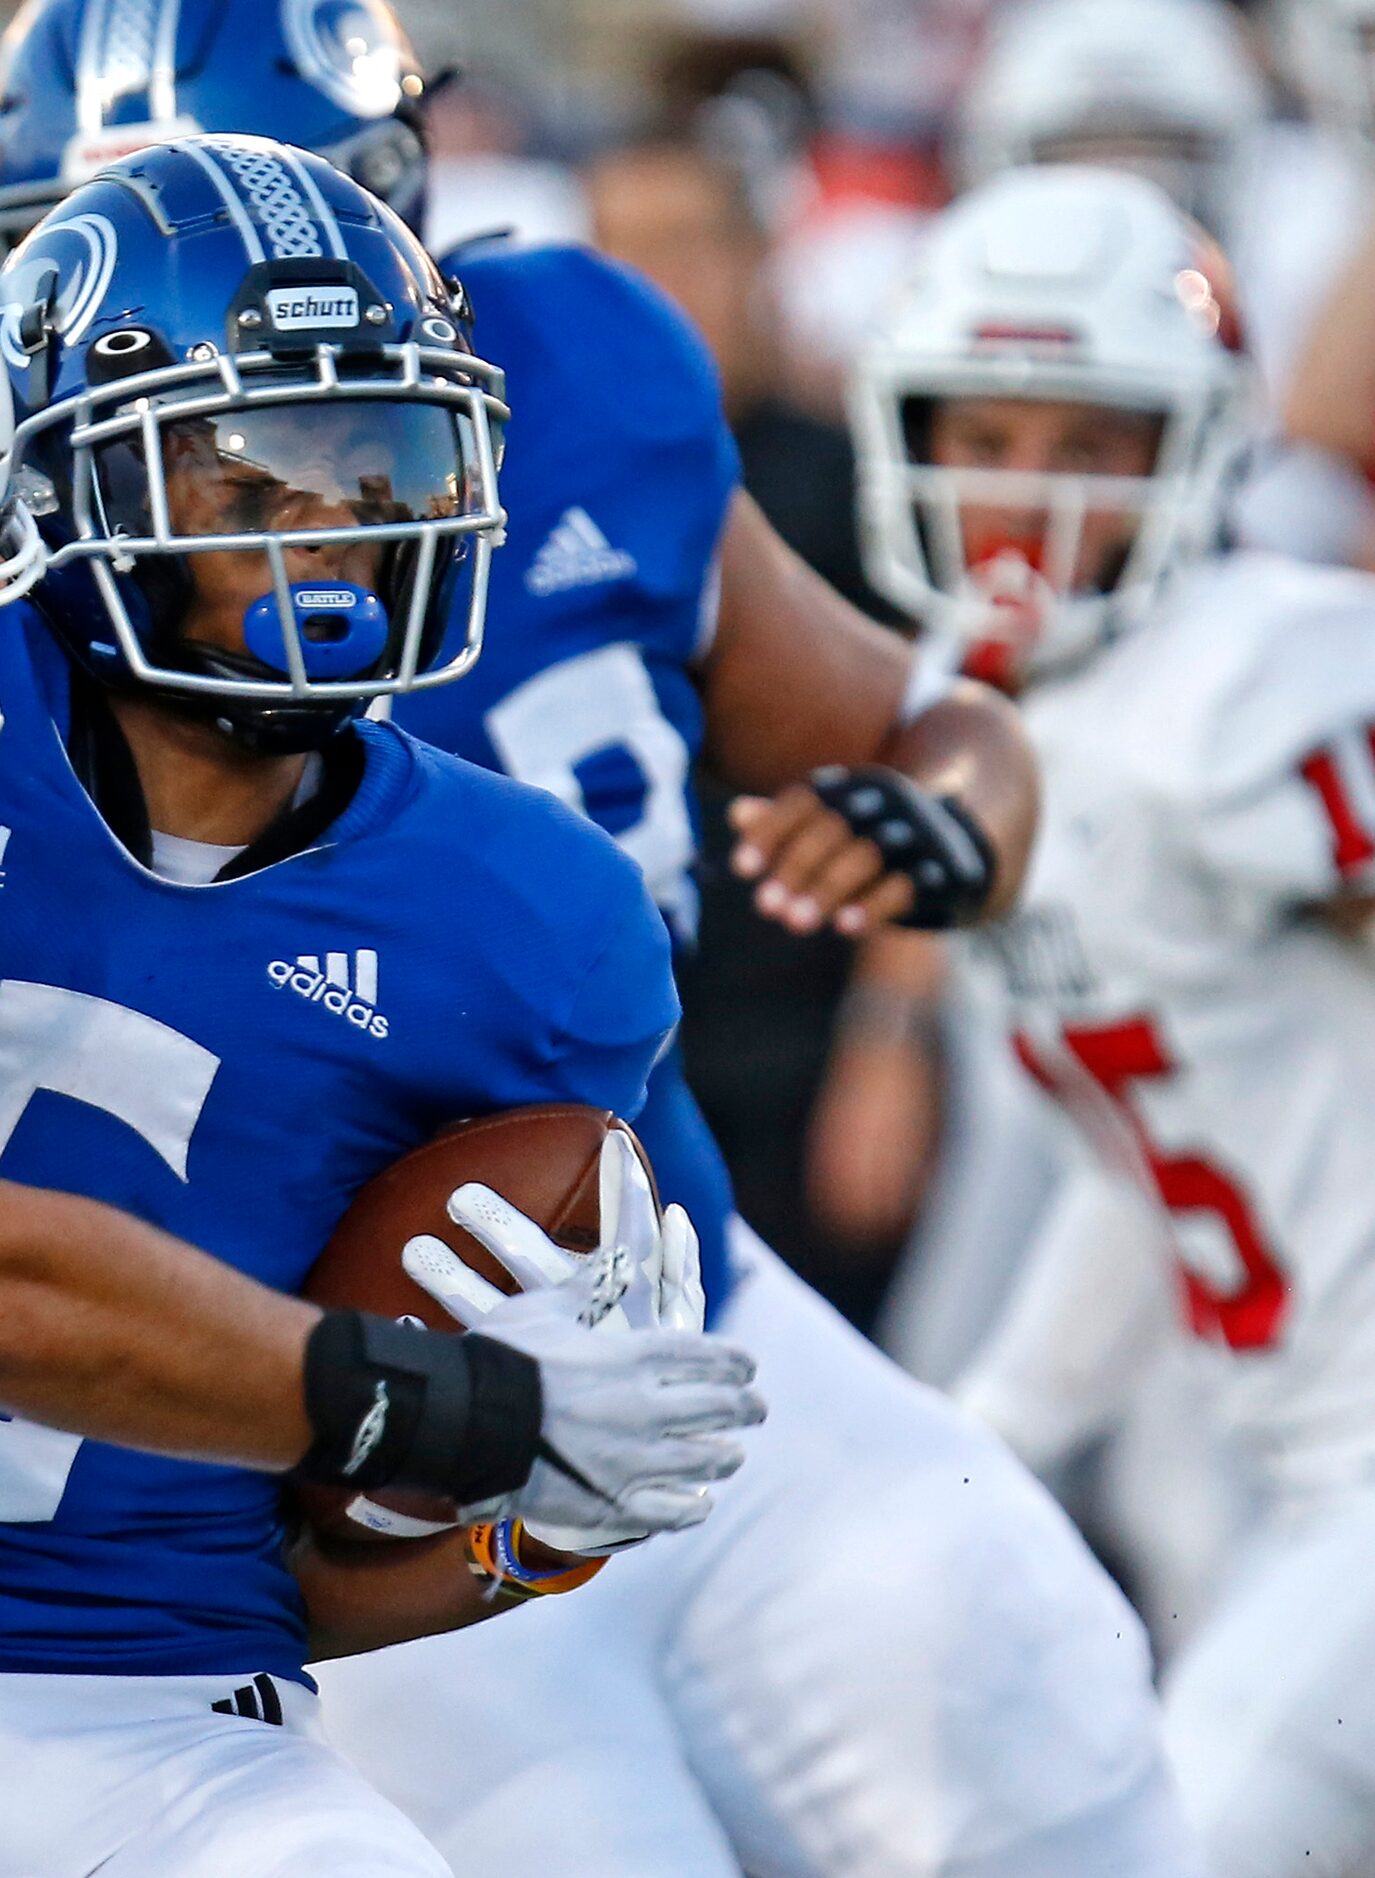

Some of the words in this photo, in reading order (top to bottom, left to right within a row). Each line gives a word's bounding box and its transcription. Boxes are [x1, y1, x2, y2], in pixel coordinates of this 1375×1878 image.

[275, 295, 356, 319] schutt
[301, 594, 352, 604] BATTLE
[267, 960, 390, 1039] adidas
